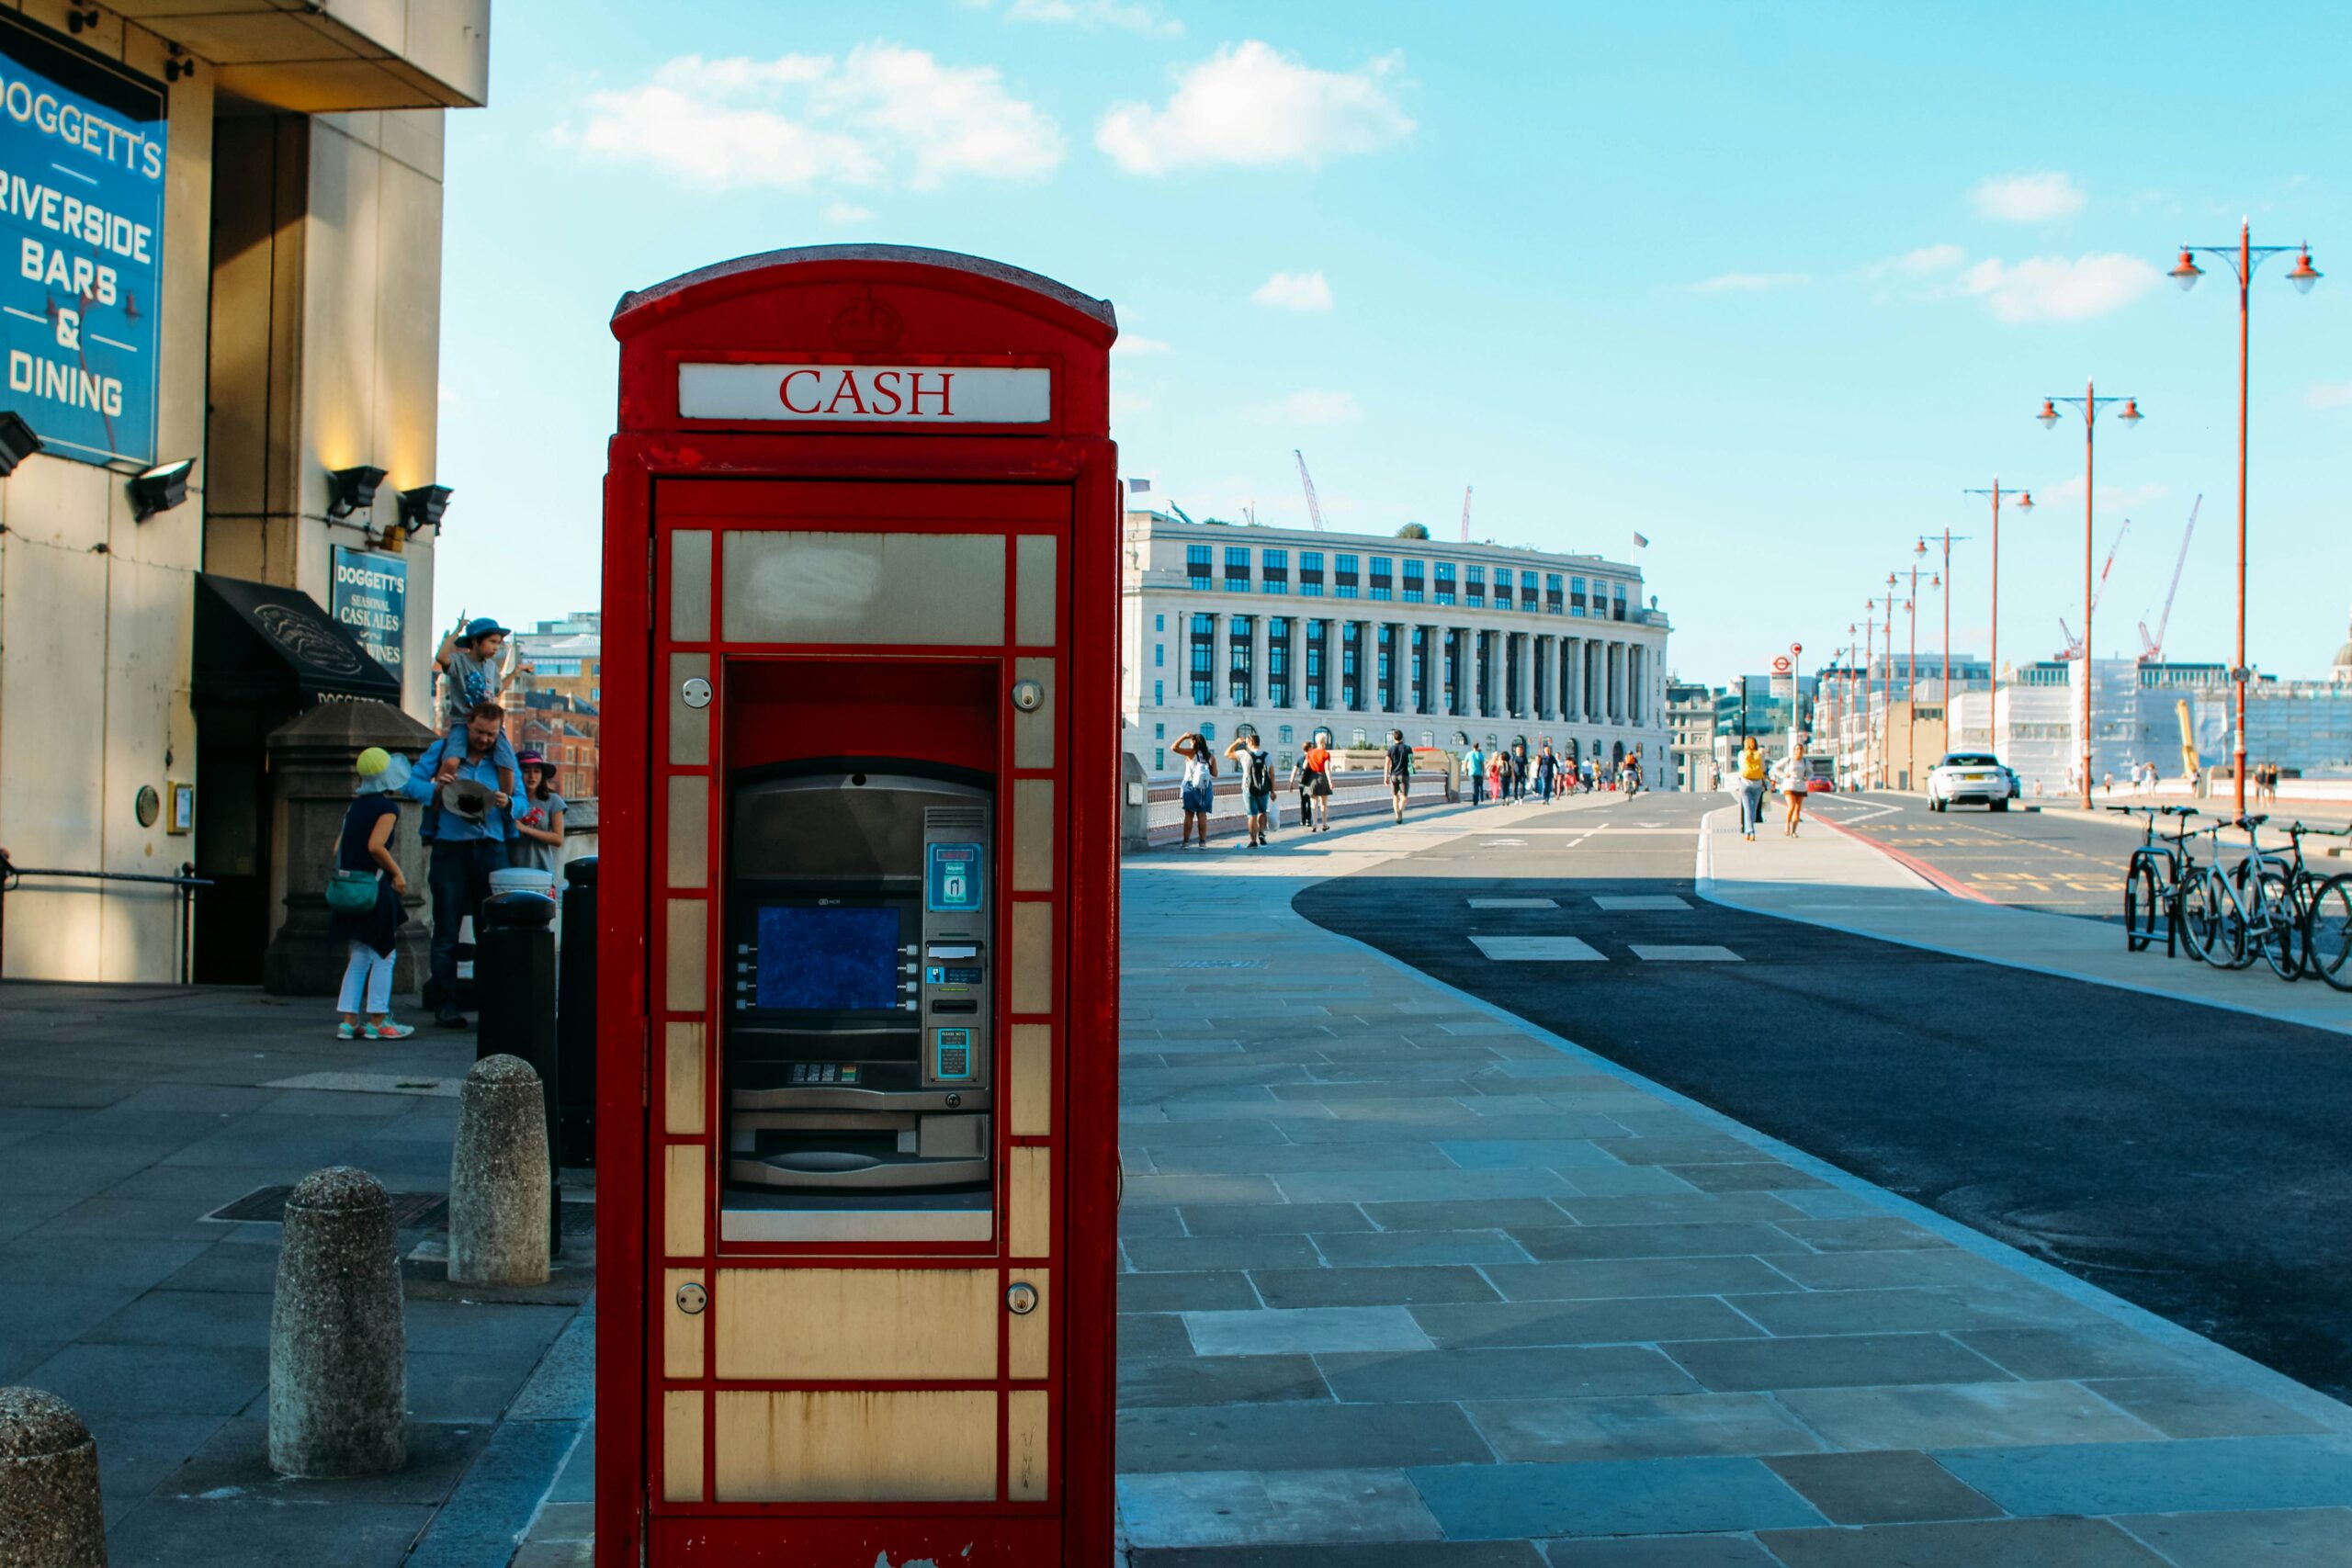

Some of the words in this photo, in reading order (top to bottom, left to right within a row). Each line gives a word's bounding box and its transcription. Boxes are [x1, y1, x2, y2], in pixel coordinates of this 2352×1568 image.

[0, 76, 162, 179] OGGETT'S
[21, 237, 117, 306] BARS
[56, 308, 81, 351] &
[9, 349, 122, 417] DINING
[779, 369, 956, 416] CASH
[337, 565, 405, 593] DOGGETT'S
[341, 606, 370, 627] CASK
[373, 611, 399, 632] ALES
[351, 594, 391, 613] SEASONAL
